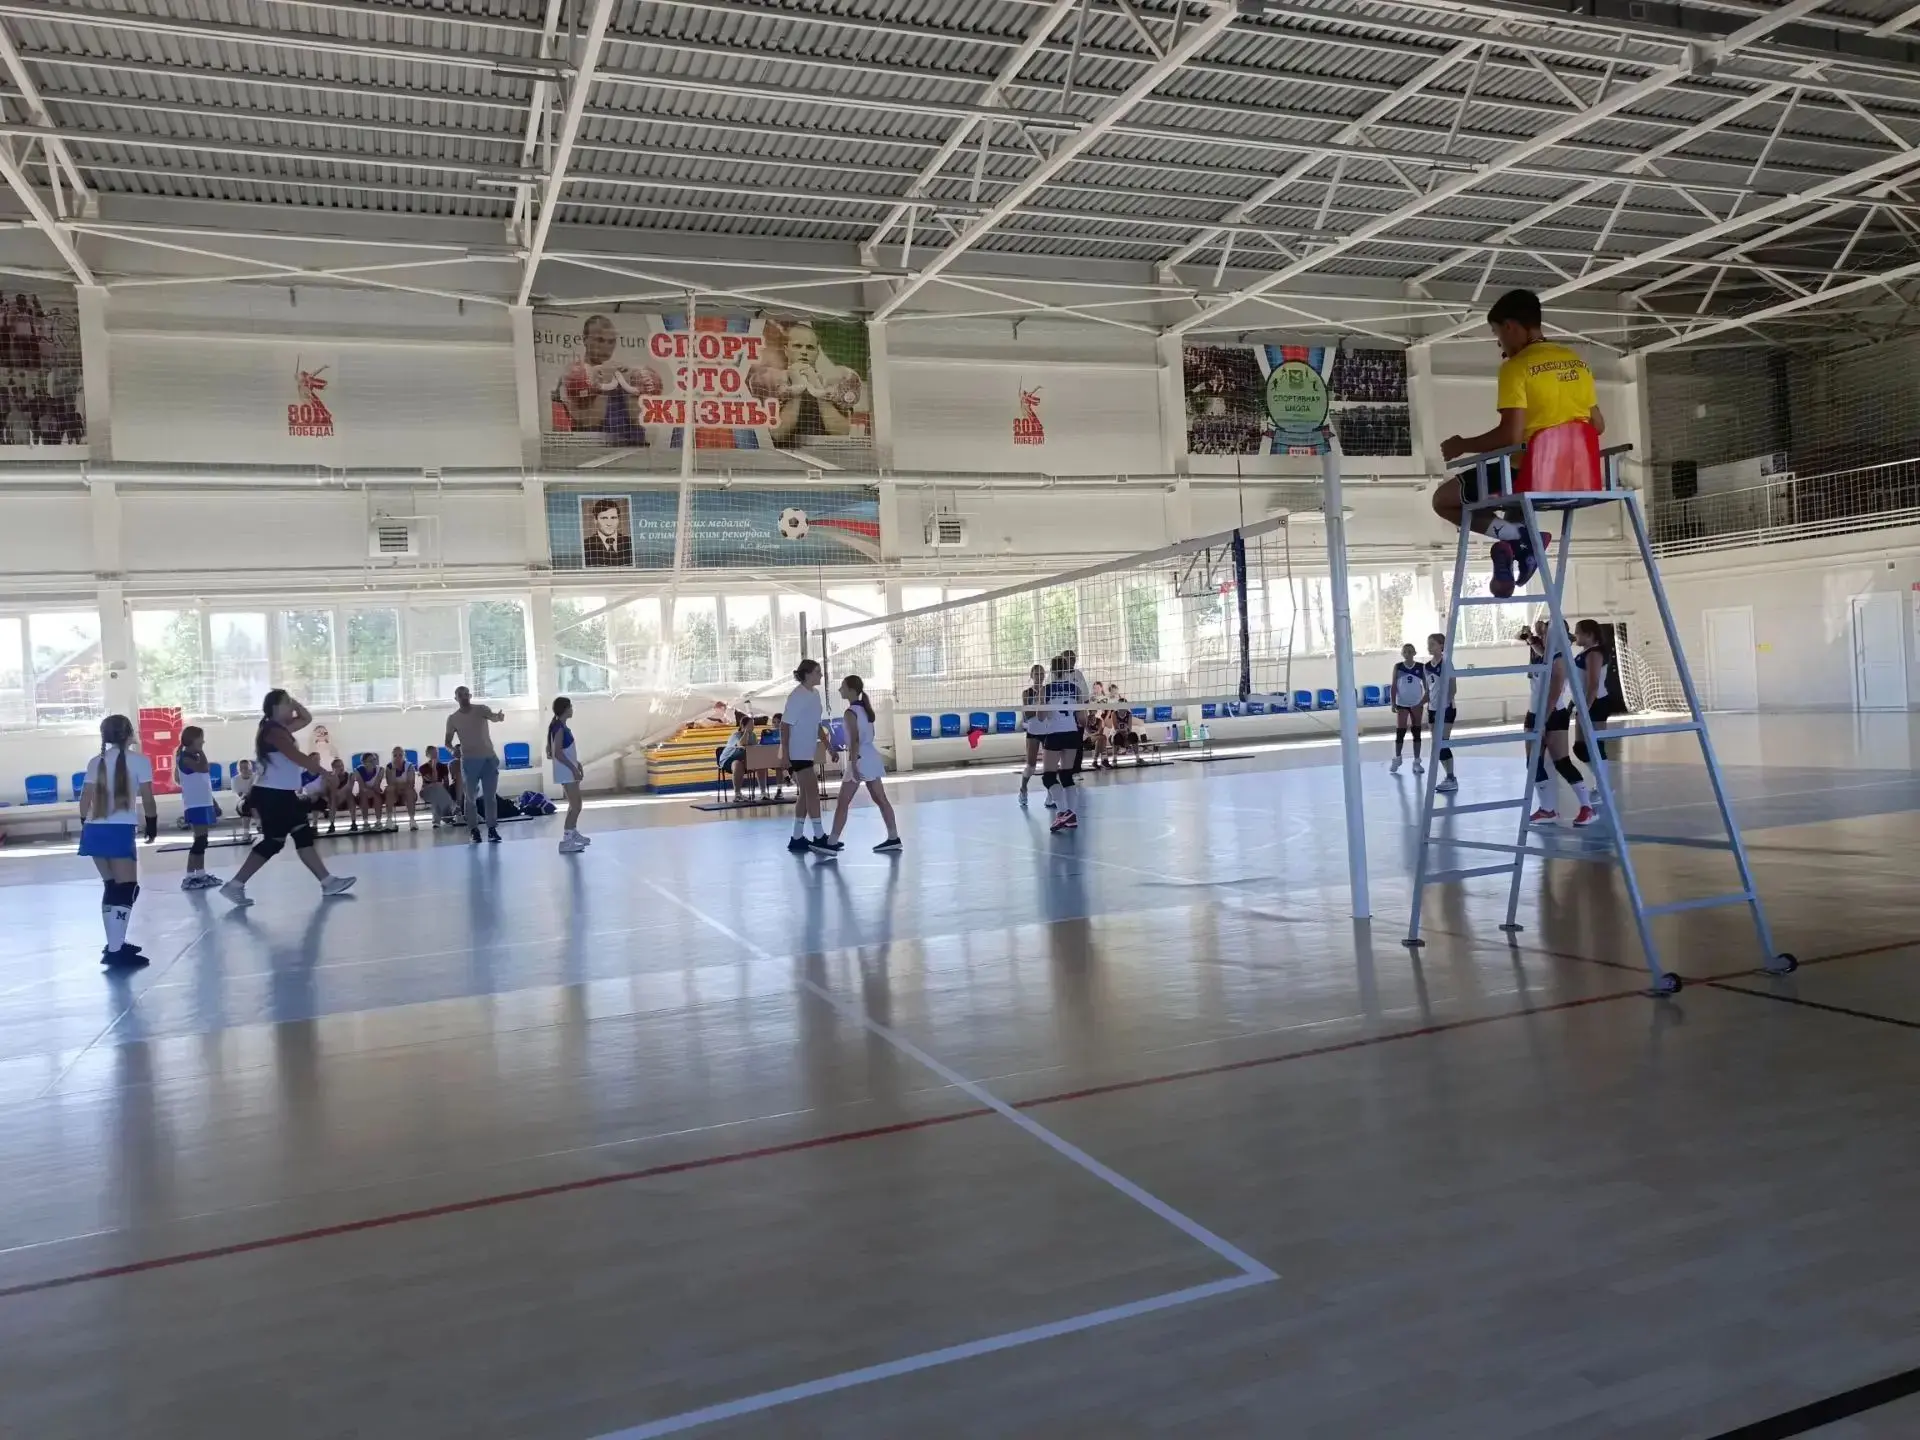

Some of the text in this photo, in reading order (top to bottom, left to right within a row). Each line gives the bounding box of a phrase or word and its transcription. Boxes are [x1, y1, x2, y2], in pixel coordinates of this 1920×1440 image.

[651, 333, 762, 360] СПОРТ
[677, 367, 741, 393] ЭТО
[643, 399, 777, 426] ЖИЗНЬ!
[1285, 404, 1311, 412] ШКОЛА
[289, 426, 334, 438] ПОБЕДА!
[639, 518, 658, 528] От
[708, 518, 752, 528] медалей
[721, 529, 771, 541] рекордам
